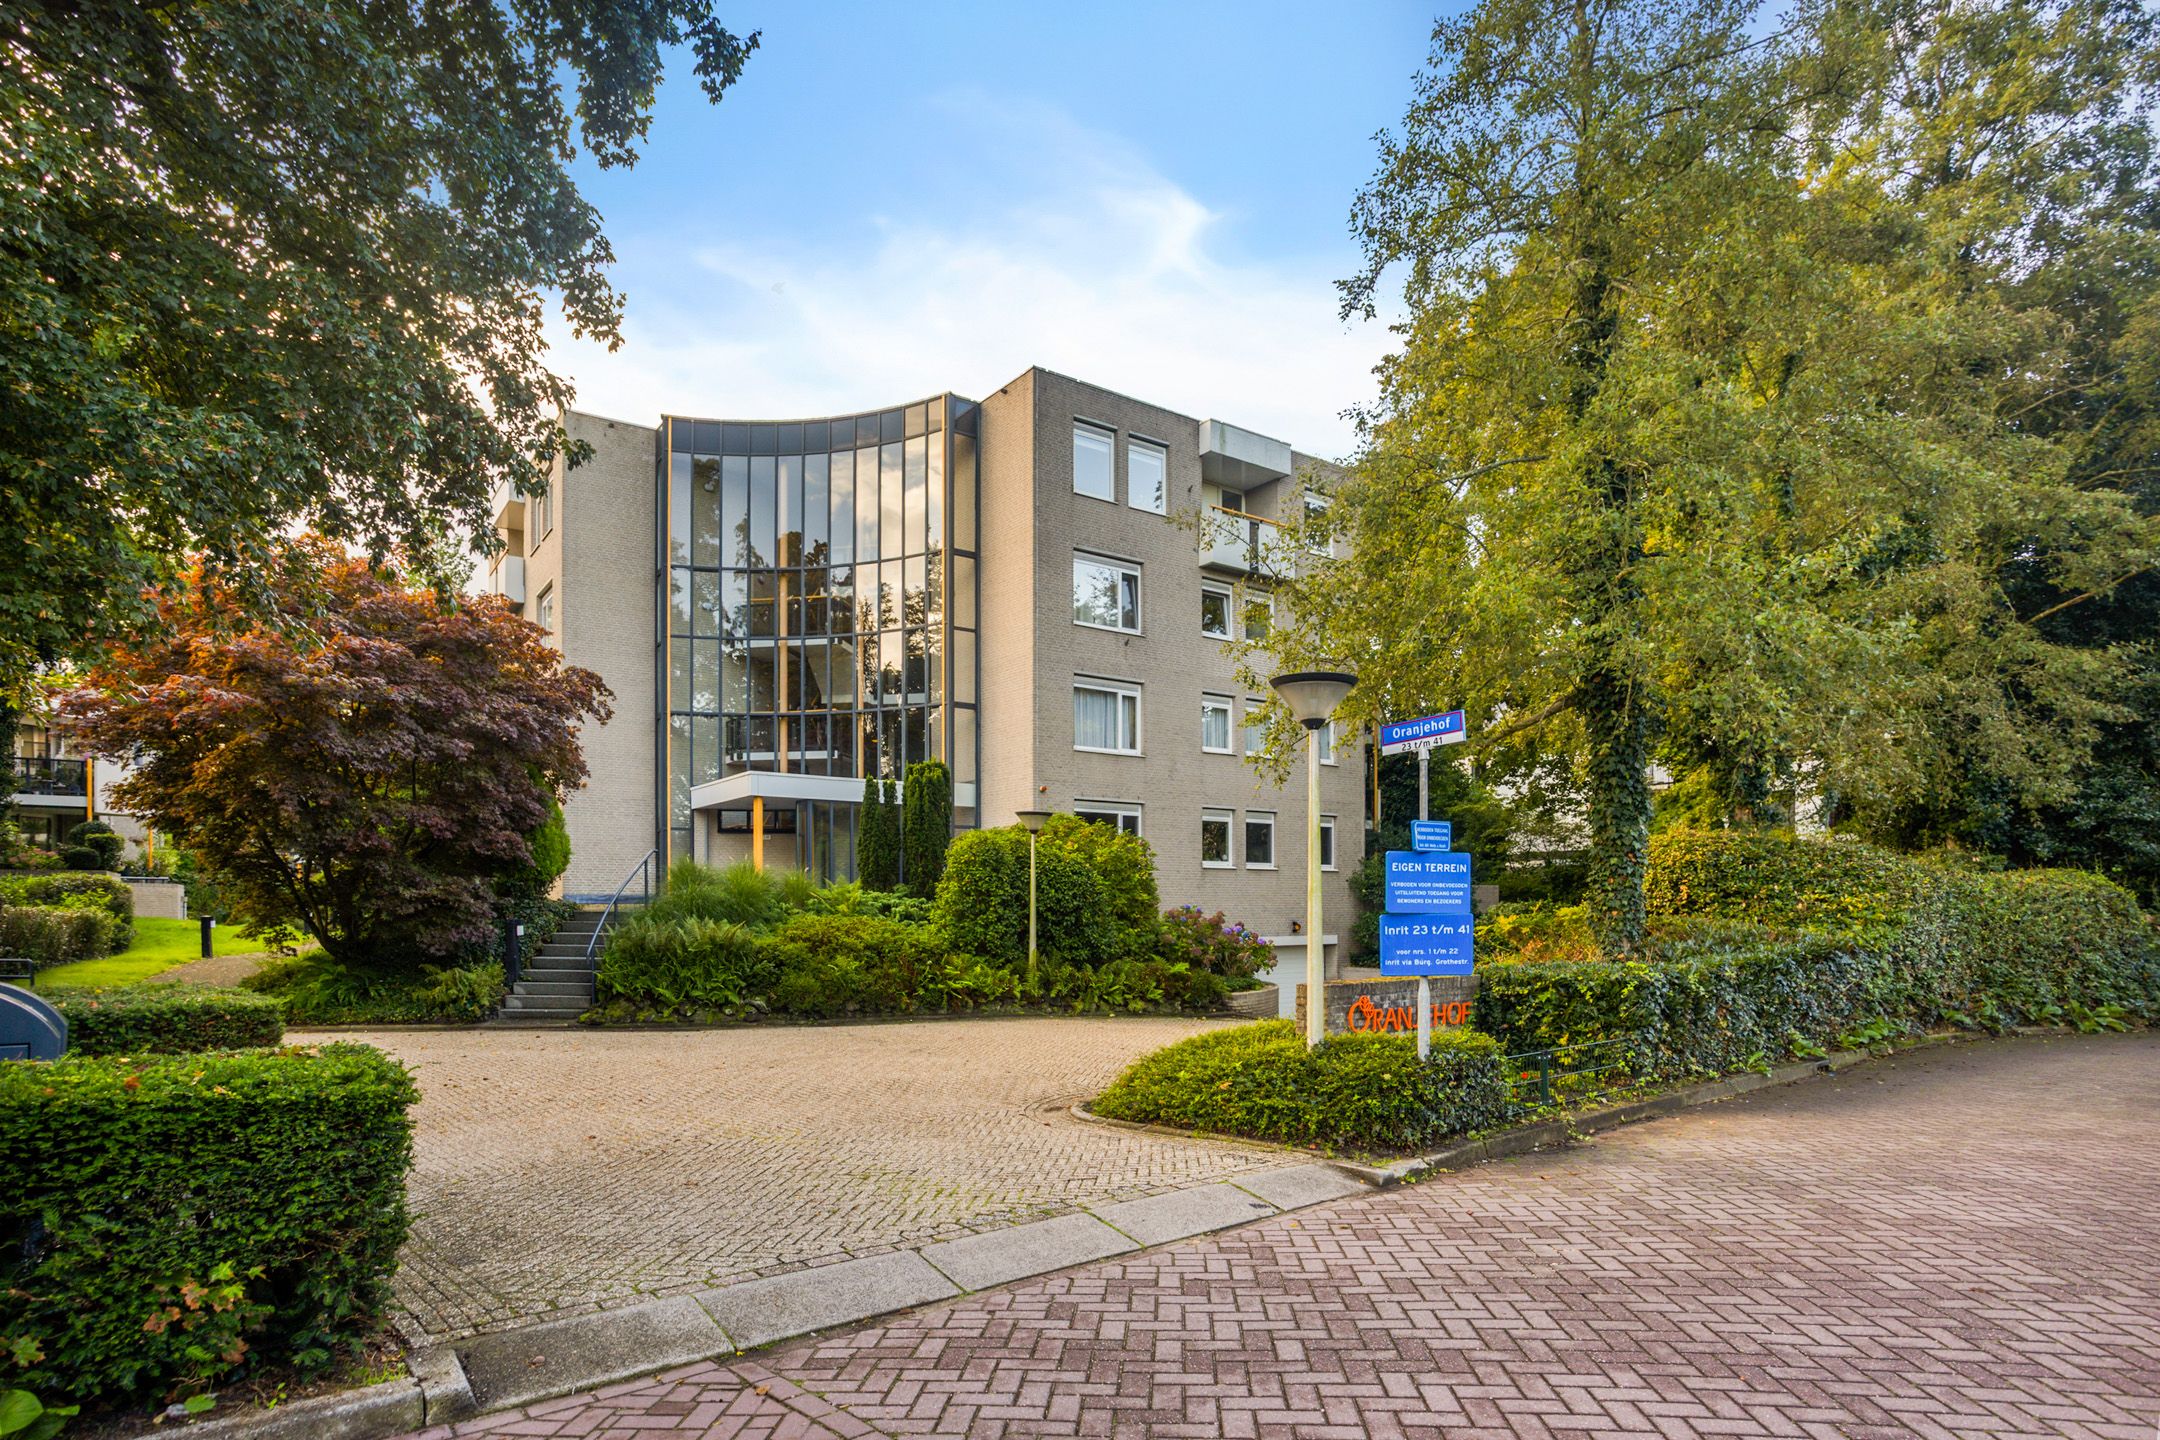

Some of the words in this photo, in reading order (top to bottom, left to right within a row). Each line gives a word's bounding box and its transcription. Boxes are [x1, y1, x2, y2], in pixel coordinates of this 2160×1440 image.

[1392, 717, 1450, 738] Oranjehof
[1401, 742, 1411, 751] 23
[1414, 740, 1431, 750] t/m
[1433, 736, 1443, 745] 41
[1392, 862, 1421, 872] EIGEN
[1425, 863, 1467, 873] TERREIN
[1384, 925, 1409, 935] Inrit
[1412, 925, 1428, 935] 23
[1431, 924, 1454, 935] t/m
[1457, 924, 1470, 934] 41
[1435, 958, 1469, 966] Grothestr.
[1347, 995, 1472, 1033] ORANHOF
